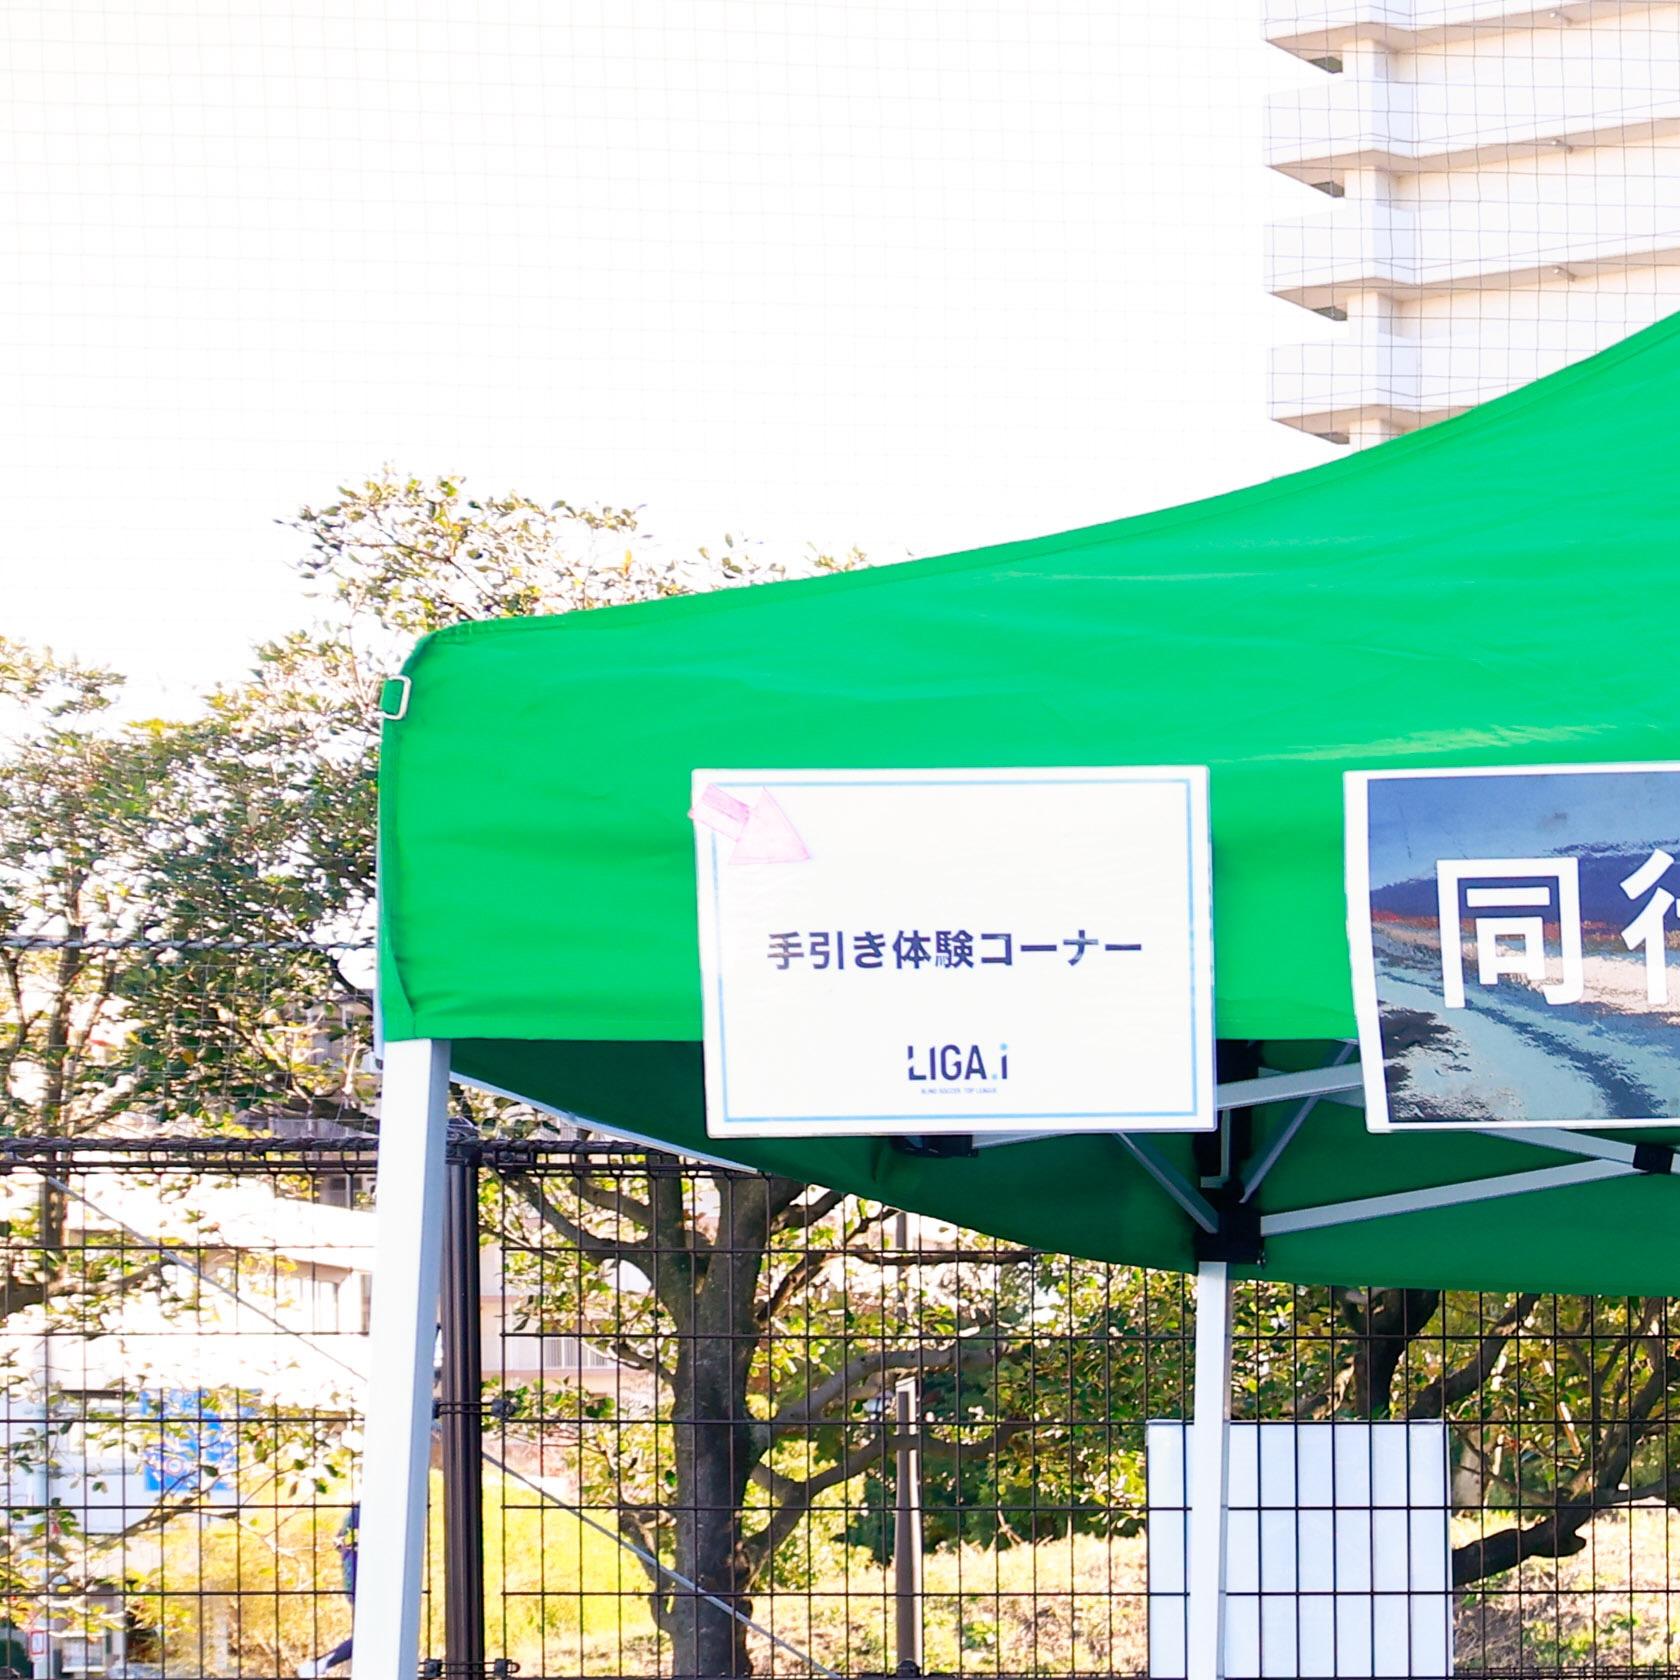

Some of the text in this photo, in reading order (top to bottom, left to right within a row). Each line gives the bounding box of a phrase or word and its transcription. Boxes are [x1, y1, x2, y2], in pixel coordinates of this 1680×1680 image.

[765, 929, 1144, 971] 手引き体験コーナー
